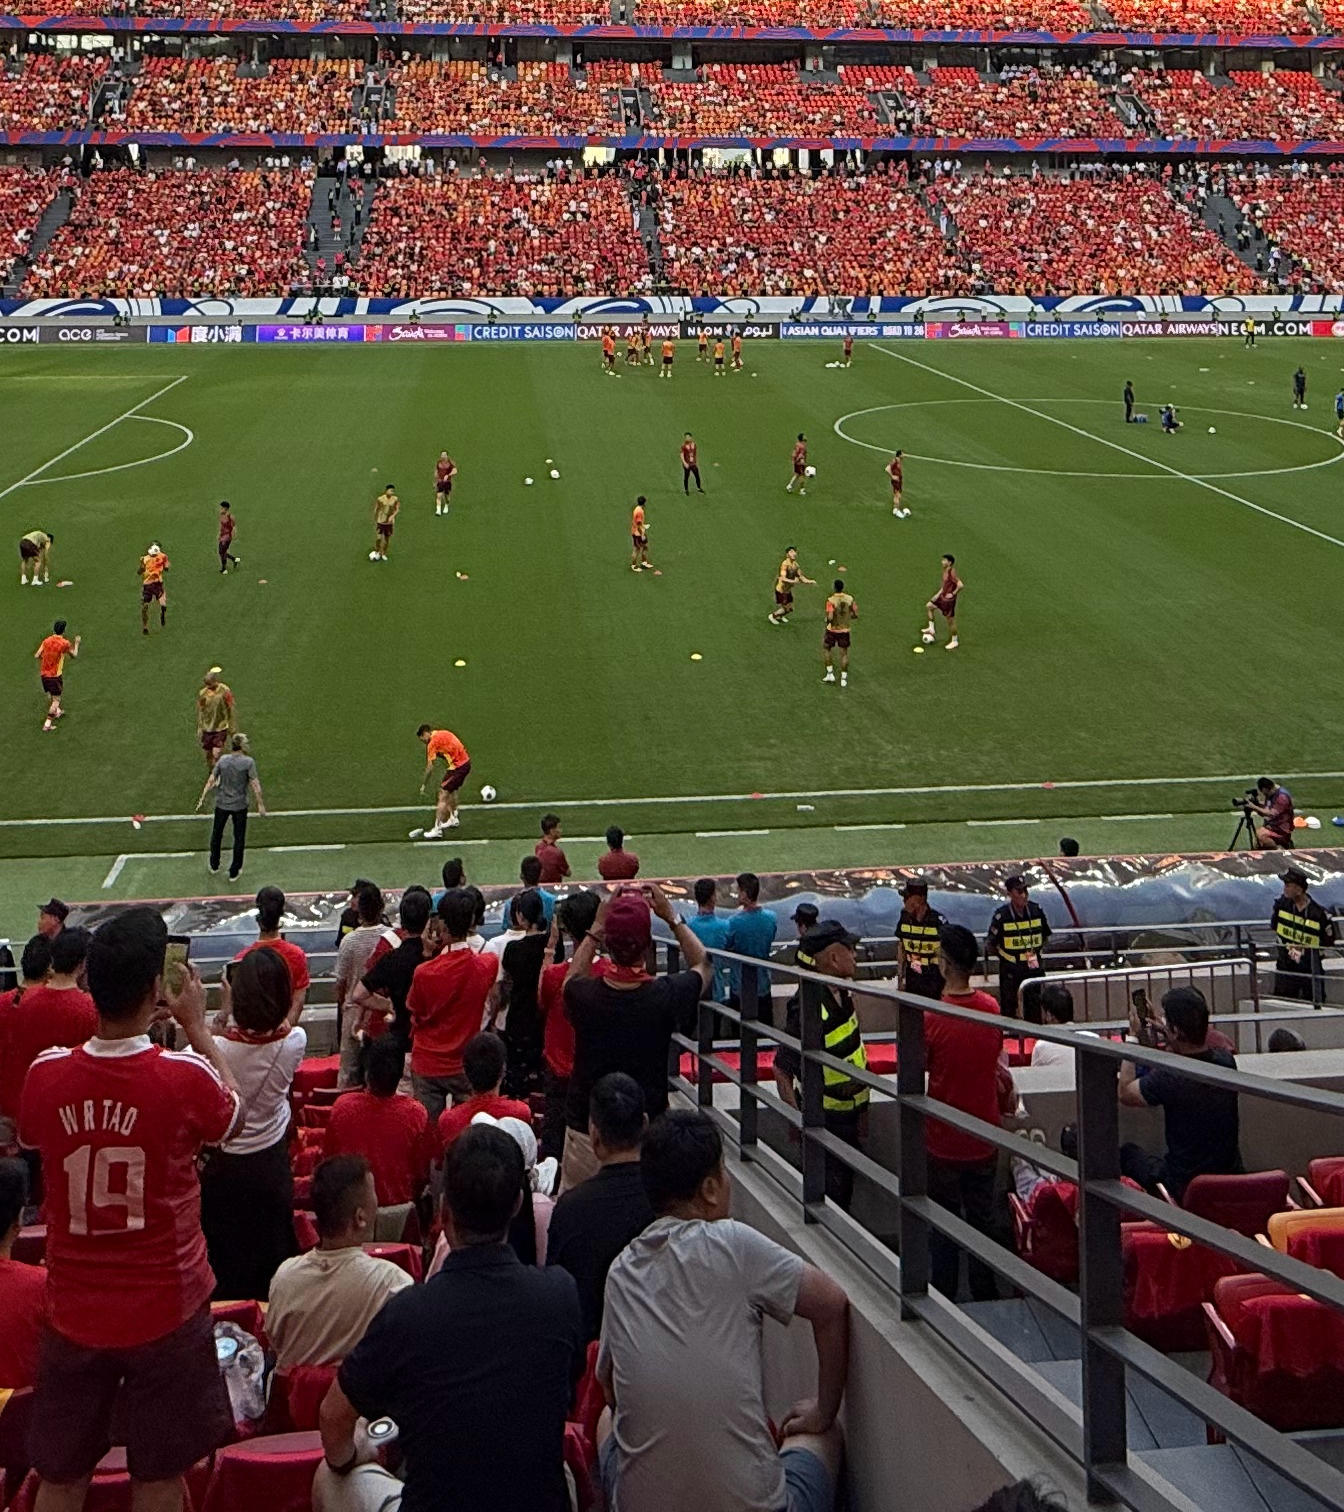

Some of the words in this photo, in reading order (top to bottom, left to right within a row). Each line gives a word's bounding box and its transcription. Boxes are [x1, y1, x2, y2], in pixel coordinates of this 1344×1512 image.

[59, 329, 91, 341] ace
[191, 325, 243, 343] 度小满
[289, 326, 349, 340] 卡尔美体育
[474, 326, 521, 338] CREDIT
[524, 326, 574, 339] SAISON
[577, 325, 620, 339] QATR
[787, 325, 818, 336] ASIAN
[1027, 323, 1070, 336] CREDIT
[1074, 323, 1119, 336] SAISON
[1123, 323, 1163, 337] QATAR
[1167, 323, 1216, 336] AIRWAYS
[63, 1144, 146, 1236] 19
